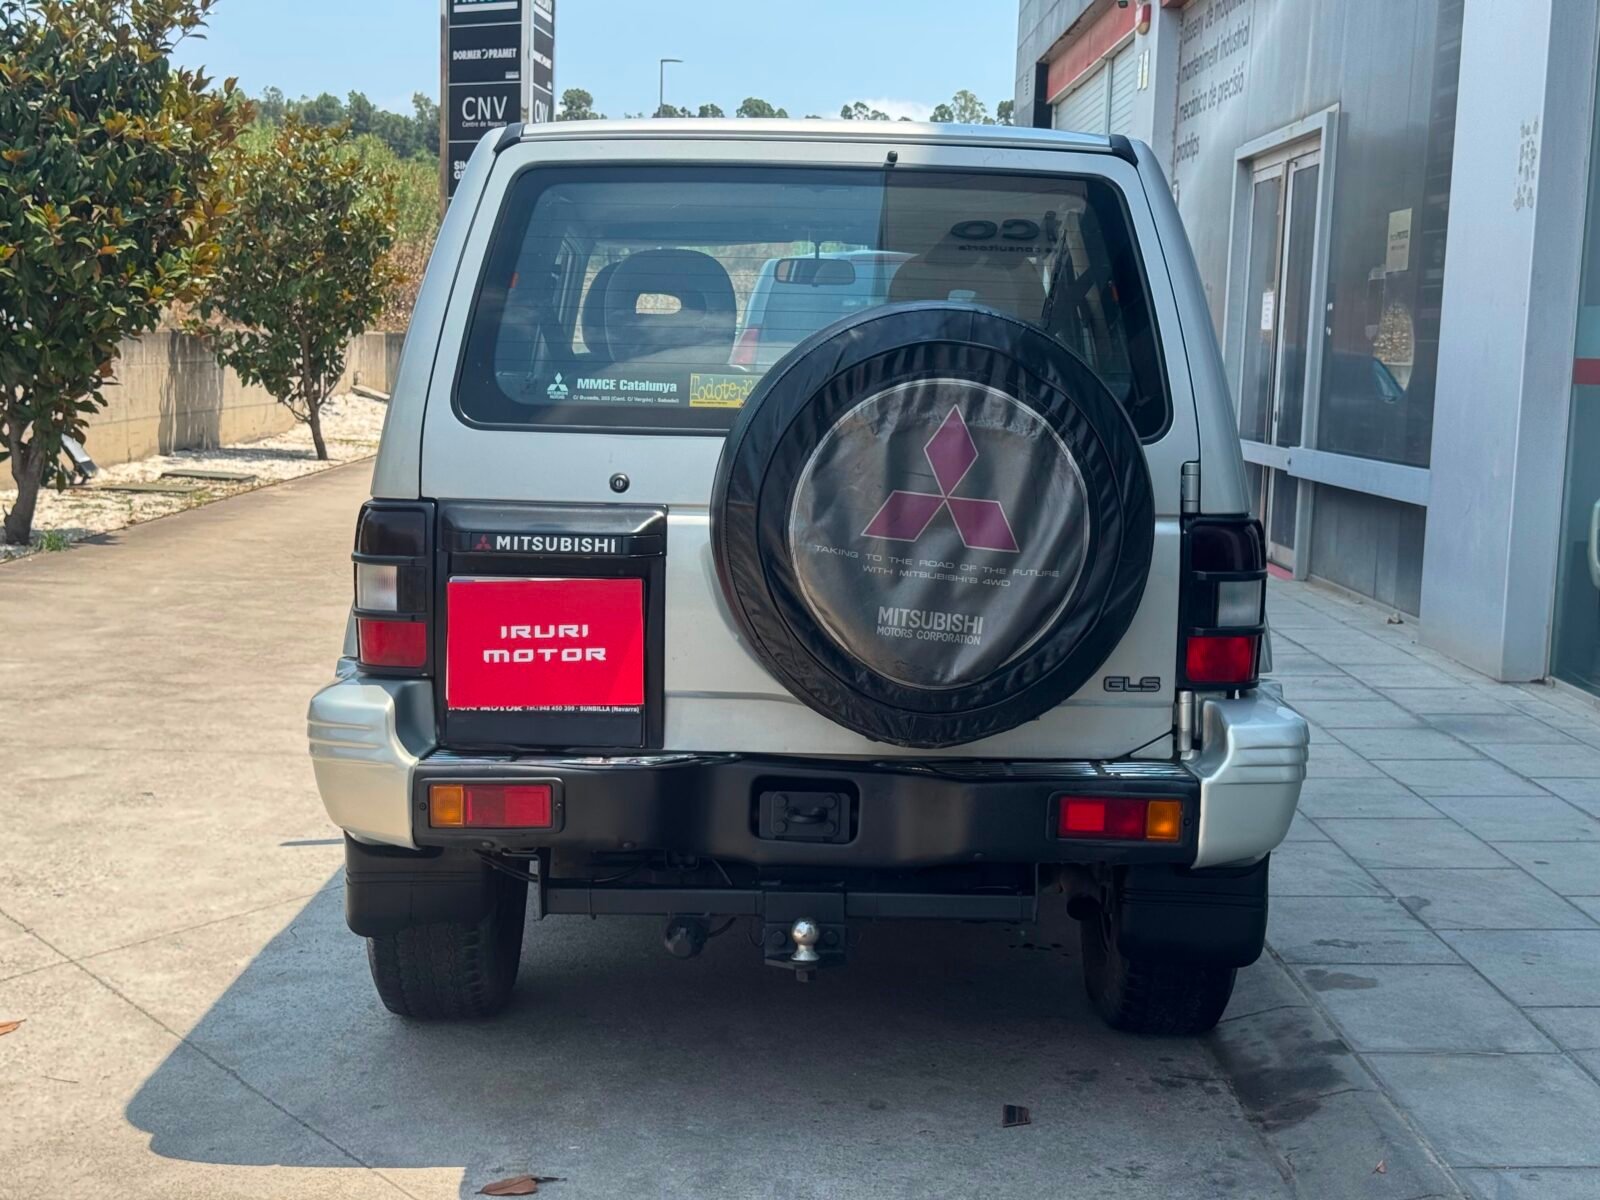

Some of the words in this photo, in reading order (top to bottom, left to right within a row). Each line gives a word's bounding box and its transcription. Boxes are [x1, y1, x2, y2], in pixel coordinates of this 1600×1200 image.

[1220, 16, 1250, 61] industrial
[453, 49, 481, 60] DORMER
[489, 48, 517, 59] PRAMET
[1207, 81, 1217, 108] de
[462, 96, 507, 120] CNV
[577, 378, 616, 390] MMCE
[619, 379, 677, 393] Catalunya
[690, 374, 753, 402] Todoterr
[496, 535, 616, 553] MITSUBISHI
[815, 544, 858, 559] TAKING
[865, 553, 882, 562] TO
[888, 556, 912, 566] THE
[919, 559, 954, 569] ROAD
[960, 563, 977, 571] OF
[982, 566, 1006, 575] THE
[1013, 568, 1060, 578] FUTURE
[862, 565, 893, 575] WITH
[899, 569, 978, 584] MITSUBISHI'S
[983, 578, 1010, 587] 4WD
[878, 606, 983, 634] MITSUBISHI
[501, 624, 588, 639] IRURI
[877, 626, 913, 639] MOTORS
[916, 630, 981, 646] CORPORATION
[483, 647, 606, 663] MOTOR
[1104, 676, 1160, 692] GLS
